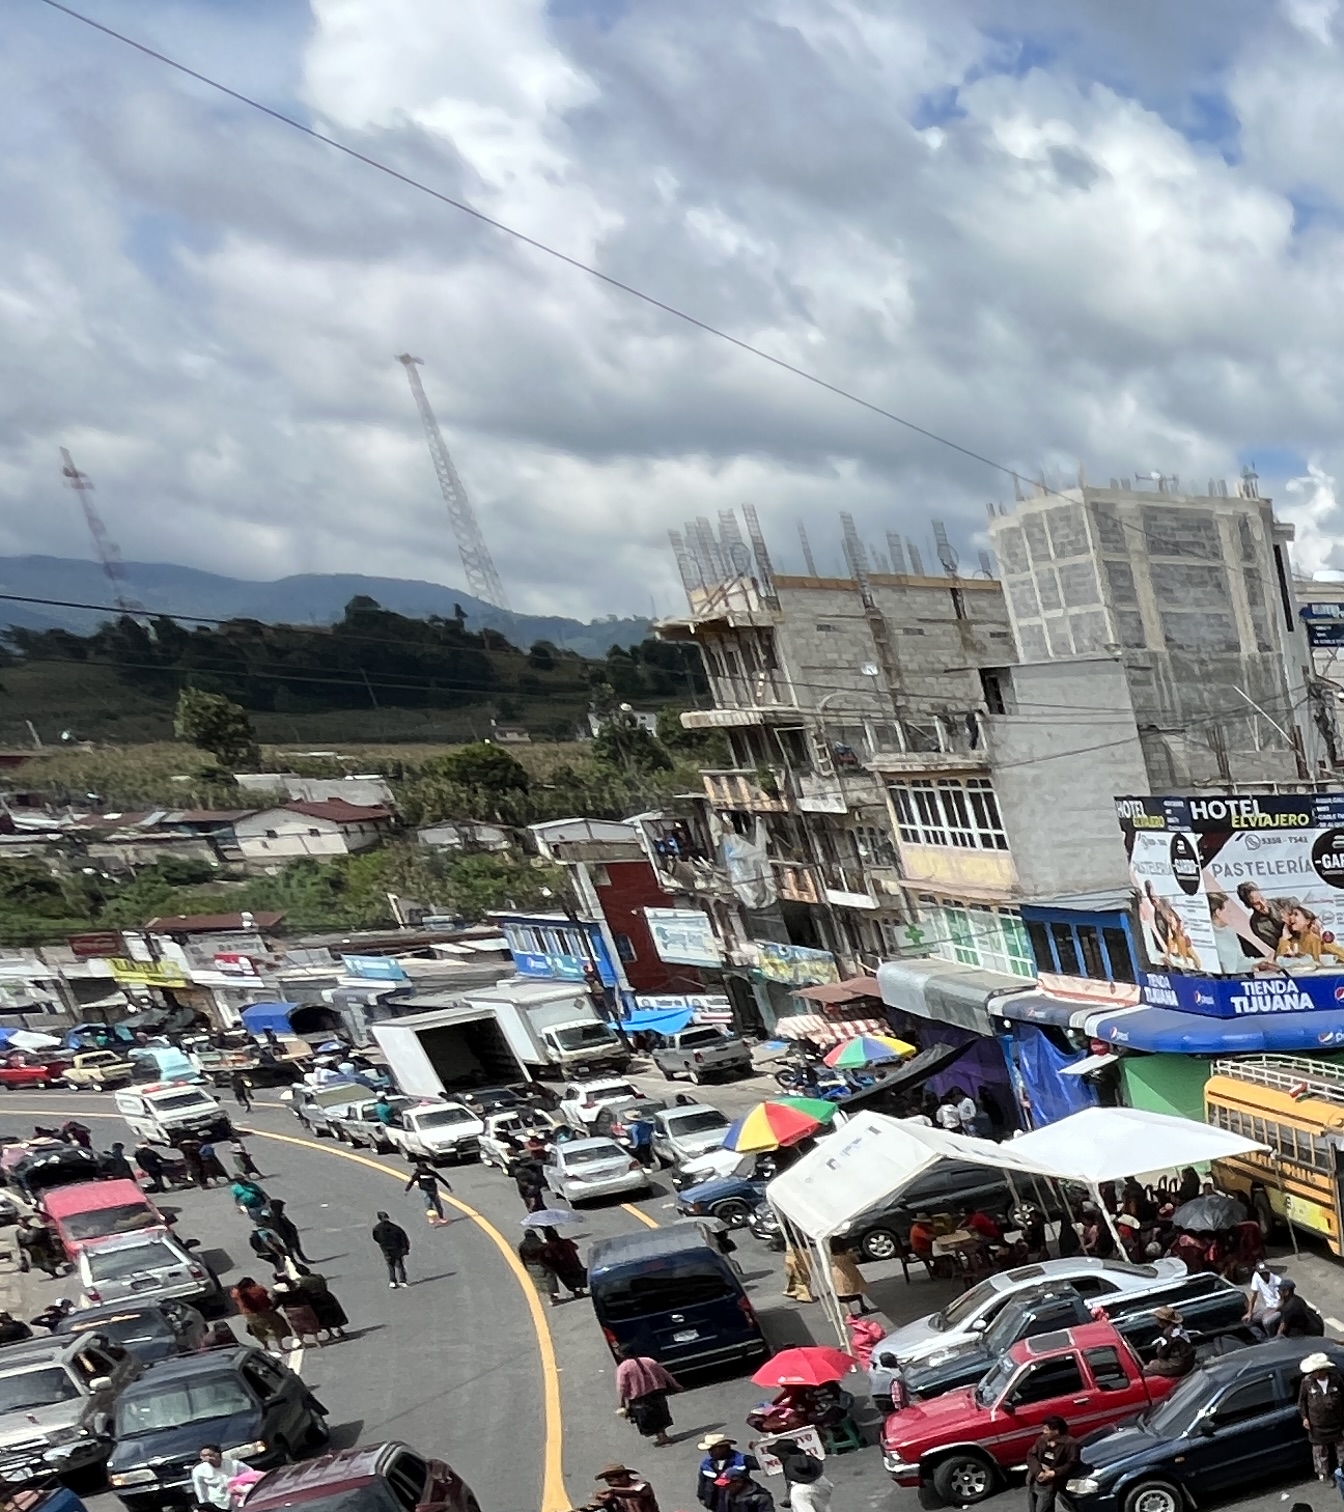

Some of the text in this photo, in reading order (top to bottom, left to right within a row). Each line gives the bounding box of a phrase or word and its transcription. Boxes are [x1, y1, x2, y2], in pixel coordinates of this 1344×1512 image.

[1190, 799, 1266, 820] HOTEL
[1212, 856, 1314, 878] PASTELERÍA
[1241, 979, 1299, 996] TIENDA
[1230, 992, 1315, 1014] TIJUANA
